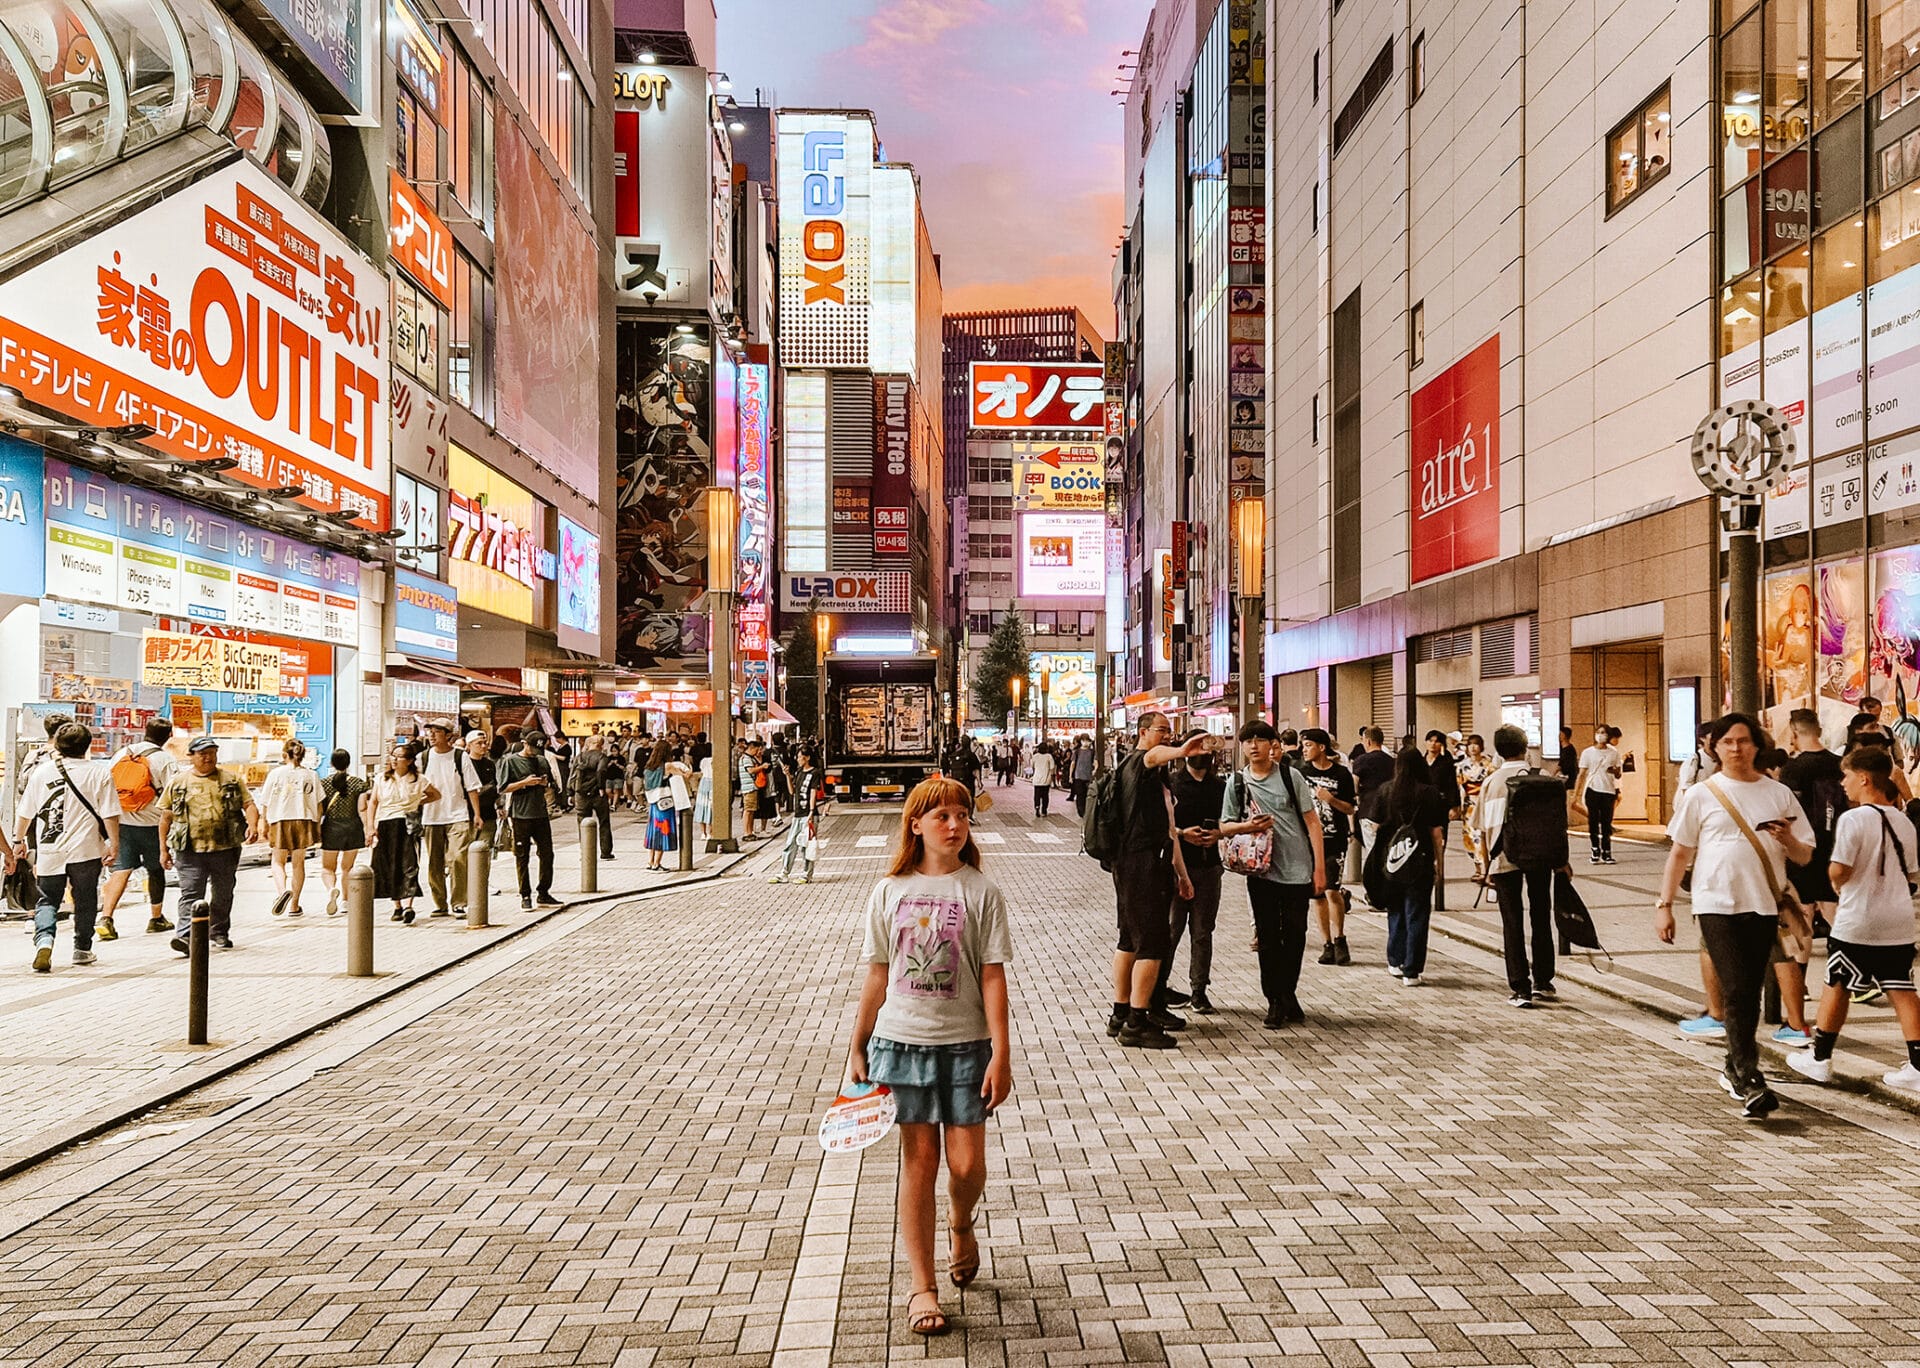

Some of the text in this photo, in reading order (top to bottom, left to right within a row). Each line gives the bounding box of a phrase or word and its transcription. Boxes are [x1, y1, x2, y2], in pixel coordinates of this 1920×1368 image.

[249, 201, 273, 231] 展示品
[1231, 209, 1264, 221] ホビー
[396, 190, 448, 288] アコム
[1232, 249, 1248, 259] 6F
[874, 380, 886, 453] Flagship Store
[1835, 398, 1898, 428] coming soon
[885, 382, 909, 475] Duty Free
[1421, 422, 1493, 512] atré 1
[51, 476, 74, 510] B1
[1821, 484, 1834, 495] ATM
[123, 494, 144, 529] 1F
[877, 511, 906, 525] 免税
[185, 514, 204, 545] 2F
[877, 535, 907, 547] 면세점
[237, 530, 254, 558] 3F
[61, 552, 103, 576] Windows
[284, 544, 299, 571] 4F
[324, 557, 337, 581] 5F
[127, 588, 151, 604] カメラ
[858, 600, 879, 608] Store
[223, 643, 278, 669] BicCamera
[223, 665, 262, 691] OUTLET
[1389, 837, 1412, 858] NIKE
[910, 981, 934, 993] Long
